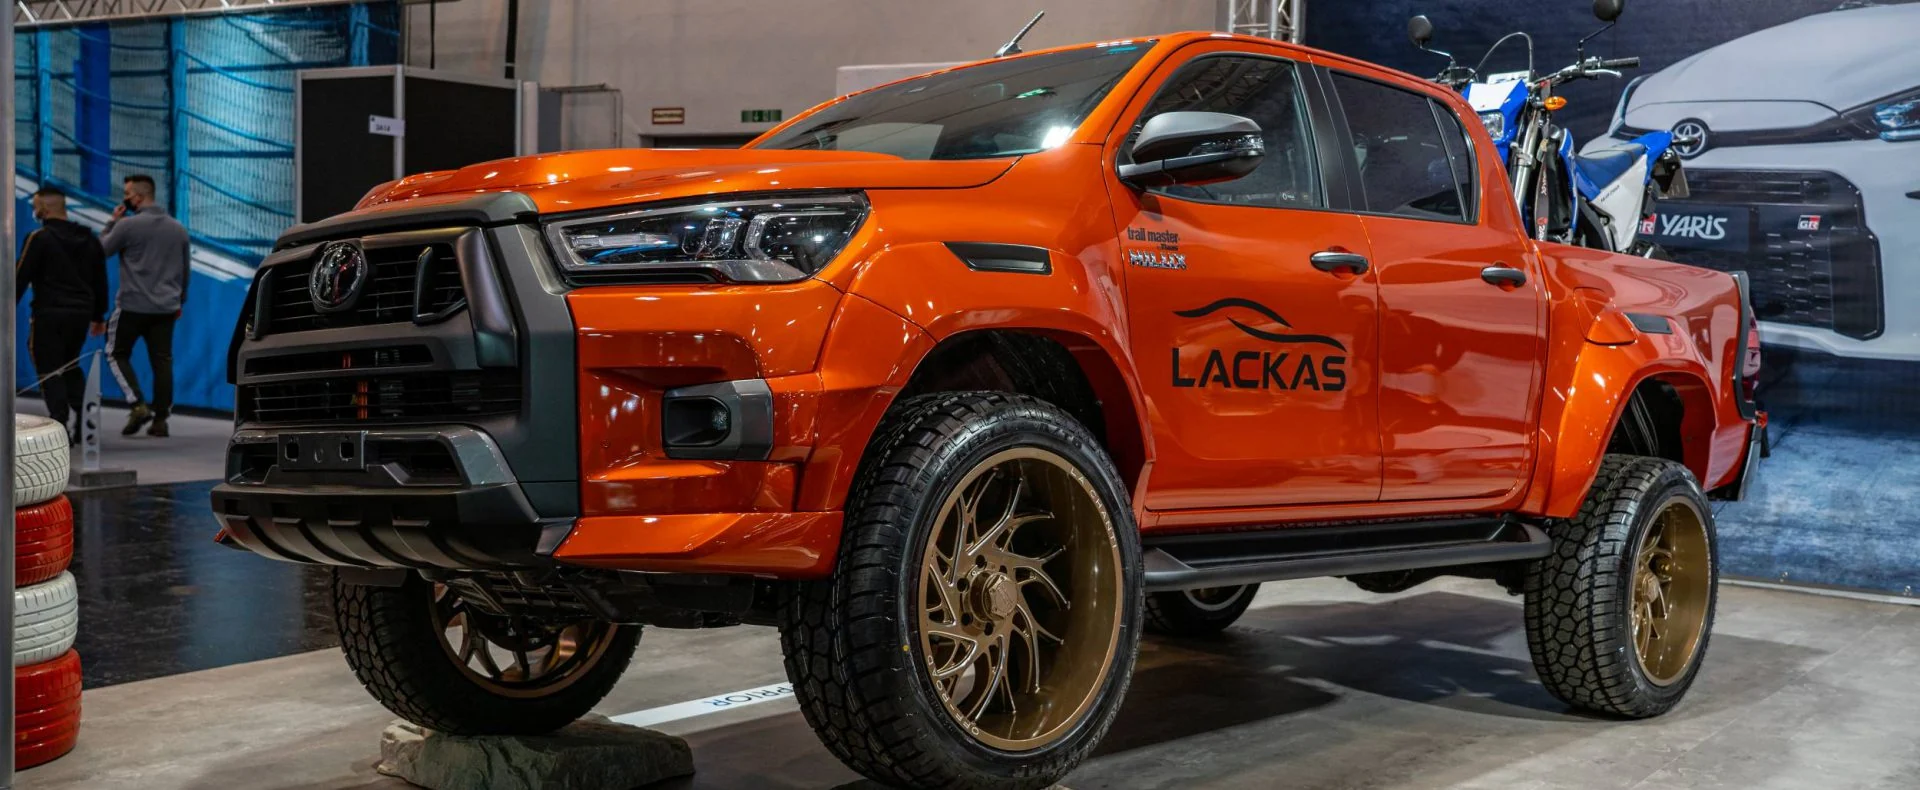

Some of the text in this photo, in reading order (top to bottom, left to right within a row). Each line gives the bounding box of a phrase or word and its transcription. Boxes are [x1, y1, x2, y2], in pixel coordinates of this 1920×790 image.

[1128, 227, 1178, 243] trail master
[1128, 249, 1187, 270] HILUX
[1172, 348, 1347, 392] LACKAS
[1070, 467, 1118, 549] LA CHANTI
[927, 655, 980, 736] OFF-ROAD
